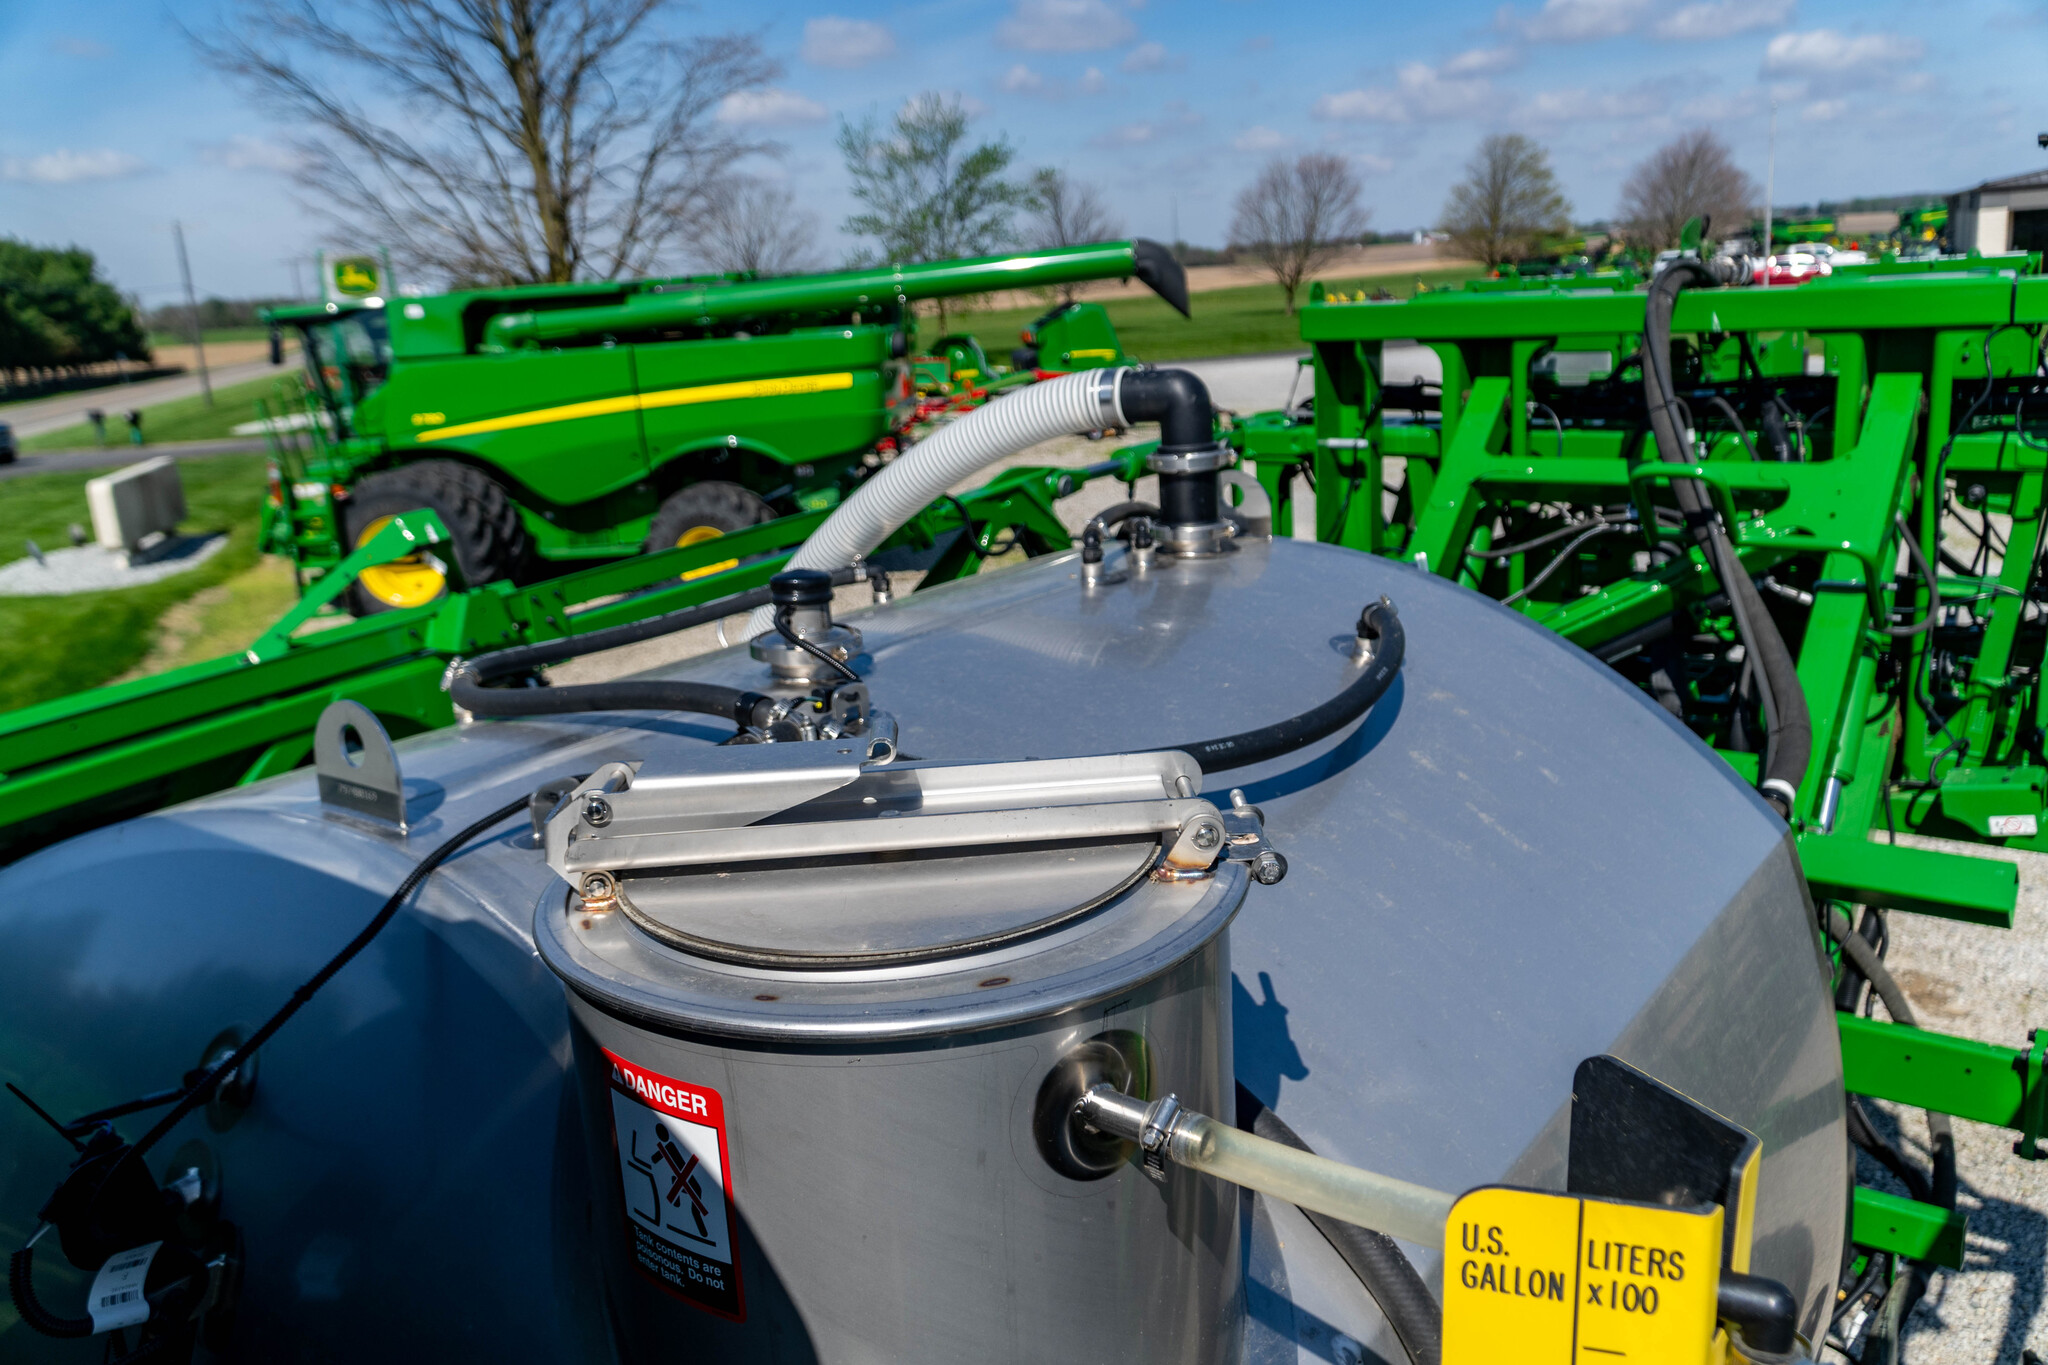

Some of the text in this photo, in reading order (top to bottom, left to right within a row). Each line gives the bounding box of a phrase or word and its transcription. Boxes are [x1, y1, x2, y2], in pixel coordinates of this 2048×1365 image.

[622, 1068, 708, 1117] DANGER
[633, 1224, 722, 1277] Tank contents are
[1462, 1222, 1510, 1256] U.S.
[1588, 1239, 1685, 1281] LITERS
[635, 1240, 726, 1291] poisonous. Do not
[660, 1266, 686, 1288] tank.
[1461, 1259, 1565, 1302] GALLON
